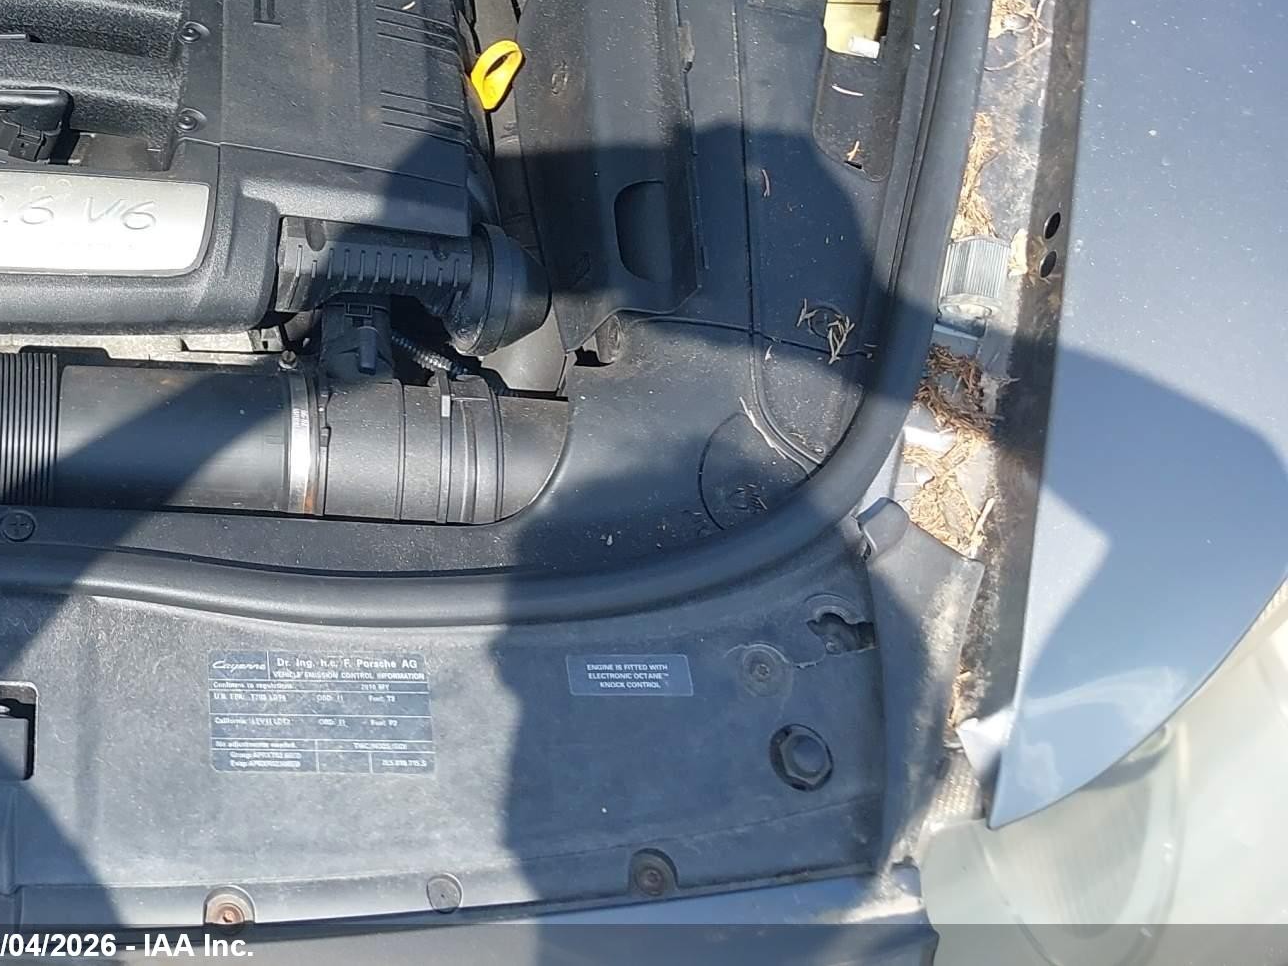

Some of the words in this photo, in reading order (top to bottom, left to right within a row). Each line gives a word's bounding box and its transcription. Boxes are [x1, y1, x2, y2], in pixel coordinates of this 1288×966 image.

[86, 196, 157, 230] V6
[277, 658, 291, 667] Dr.
[296, 658, 315, 668] Ing.
[343, 659, 352, 668] F.
[357, 659, 397, 668] Porsche
[402, 660, 417, 669] AG
[341, 671, 374, 679] CONTROL
[376, 672, 425, 680] INFORMATION
